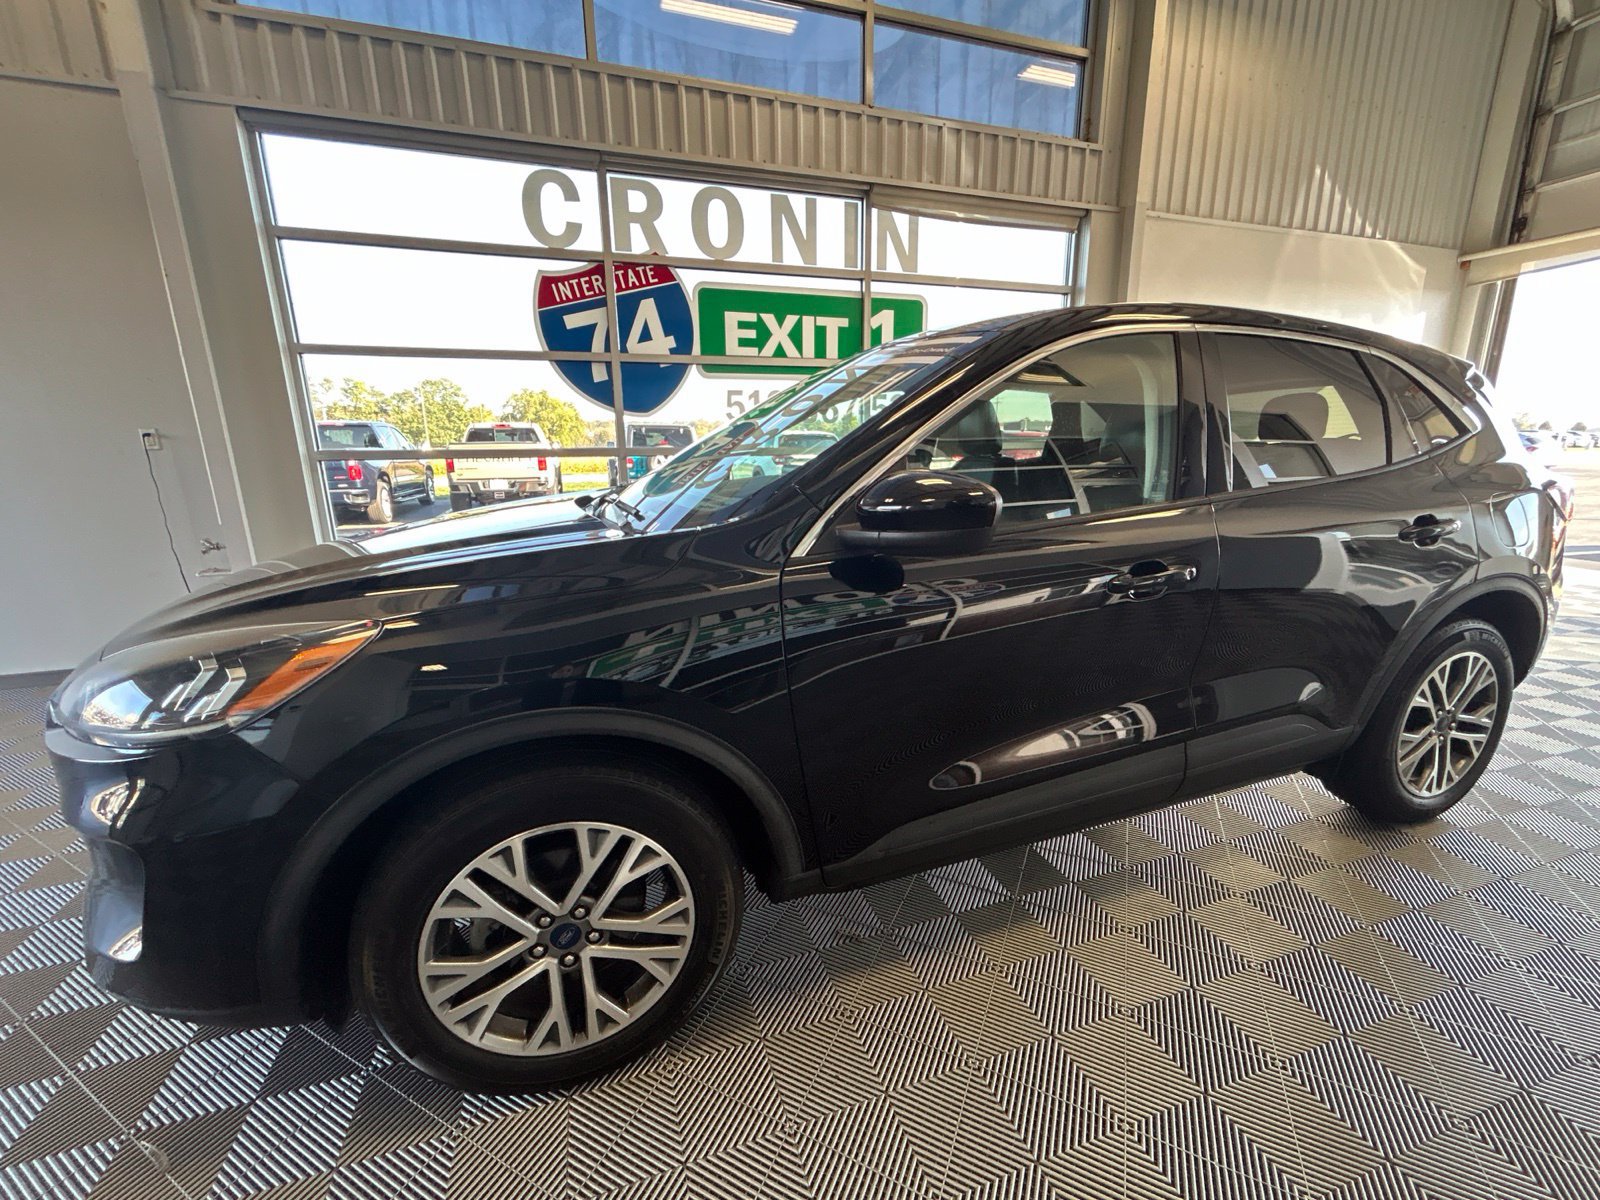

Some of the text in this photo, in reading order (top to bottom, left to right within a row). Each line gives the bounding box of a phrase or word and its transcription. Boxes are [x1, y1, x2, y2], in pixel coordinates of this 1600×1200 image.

[522, 169, 919, 273] CRONIN
[551, 265, 659, 302] INTERTATE
[563, 297, 676, 383] 74
[724, 311, 848, 359] EXIT
